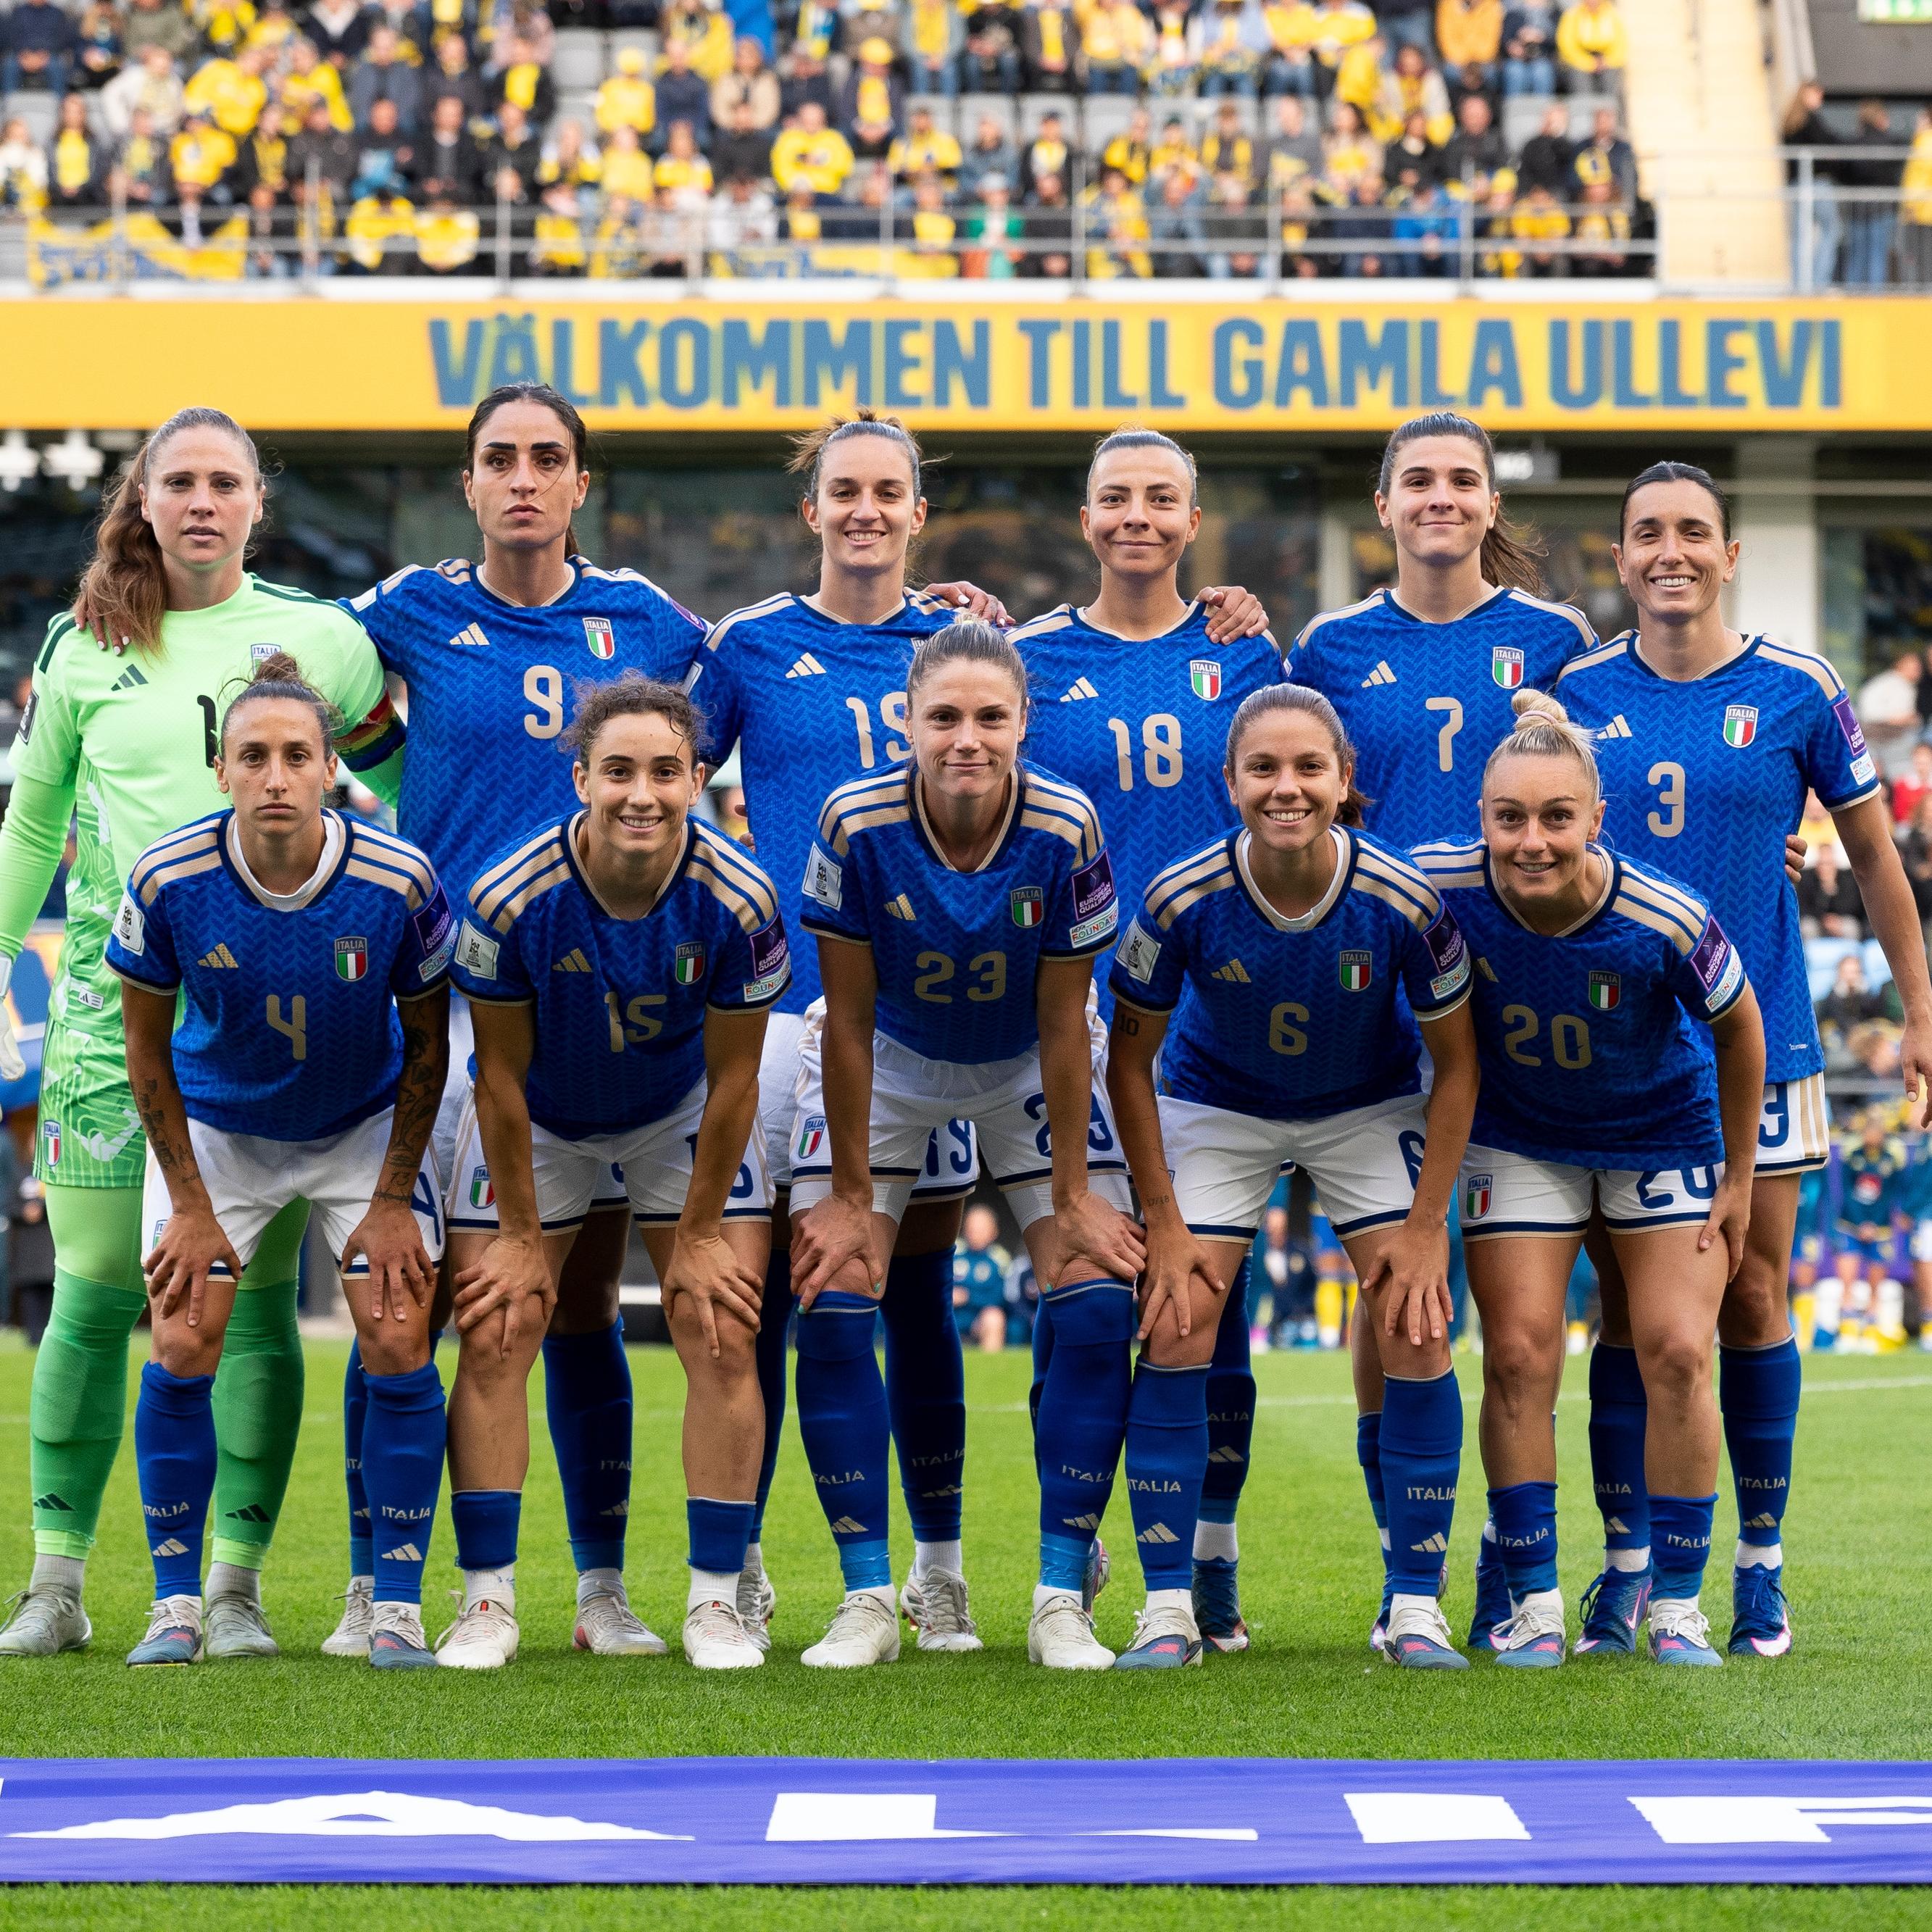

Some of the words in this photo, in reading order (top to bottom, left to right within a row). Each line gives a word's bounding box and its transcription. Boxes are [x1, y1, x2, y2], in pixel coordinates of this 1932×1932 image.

[430, 312, 990, 408] VÄLKOMMEN
[1019, 320, 1186, 409] TILL
[1212, 318, 1522, 409] GAMLA
[1549, 320, 1842, 409] ULLEVI
[587, 620, 609, 630] ITALIA
[1496, 650, 1520, 659] ITALIA
[1193, 663, 1217, 673] ITALIA
[523, 665, 563, 739] 9
[1728, 709, 1754, 719] ITALIA
[1425, 697, 1463, 772] 7
[1108, 713, 1183, 791] 18
[1646, 761, 1685, 838] 3
[1014, 890, 1039, 901] ITALIA
[1079, 881, 1111, 908] EUROPEAN
[338, 941, 364, 950] ITALIA
[678, 944, 702, 957] ITALIA
[1342, 953, 1369, 962] ITALIA
[914, 951, 1007, 1004] 23
[1591, 973, 1617, 984] ITALIA
[266, 994, 307, 1061] 4
[604, 991, 667, 1053] 15
[1269, 1002, 1309, 1056] 6
[1502, 1004, 1592, 1070] 20
[411, 1172, 441, 1246] 4
[1128, 1478, 1181, 1493] ITALIA
[1739, 1476, 1786, 1489] ITALIA
[1407, 1487, 1455, 1500] ITALIA
[143, 1502, 189, 1517] ITALIA
[383, 1505, 430, 1520] ITALIA
[1500, 1527, 1549, 1548] ITALIA
[1667, 1533, 1710, 1549] ITALIA
[0, 1778, 1932, 1844] ALIF
